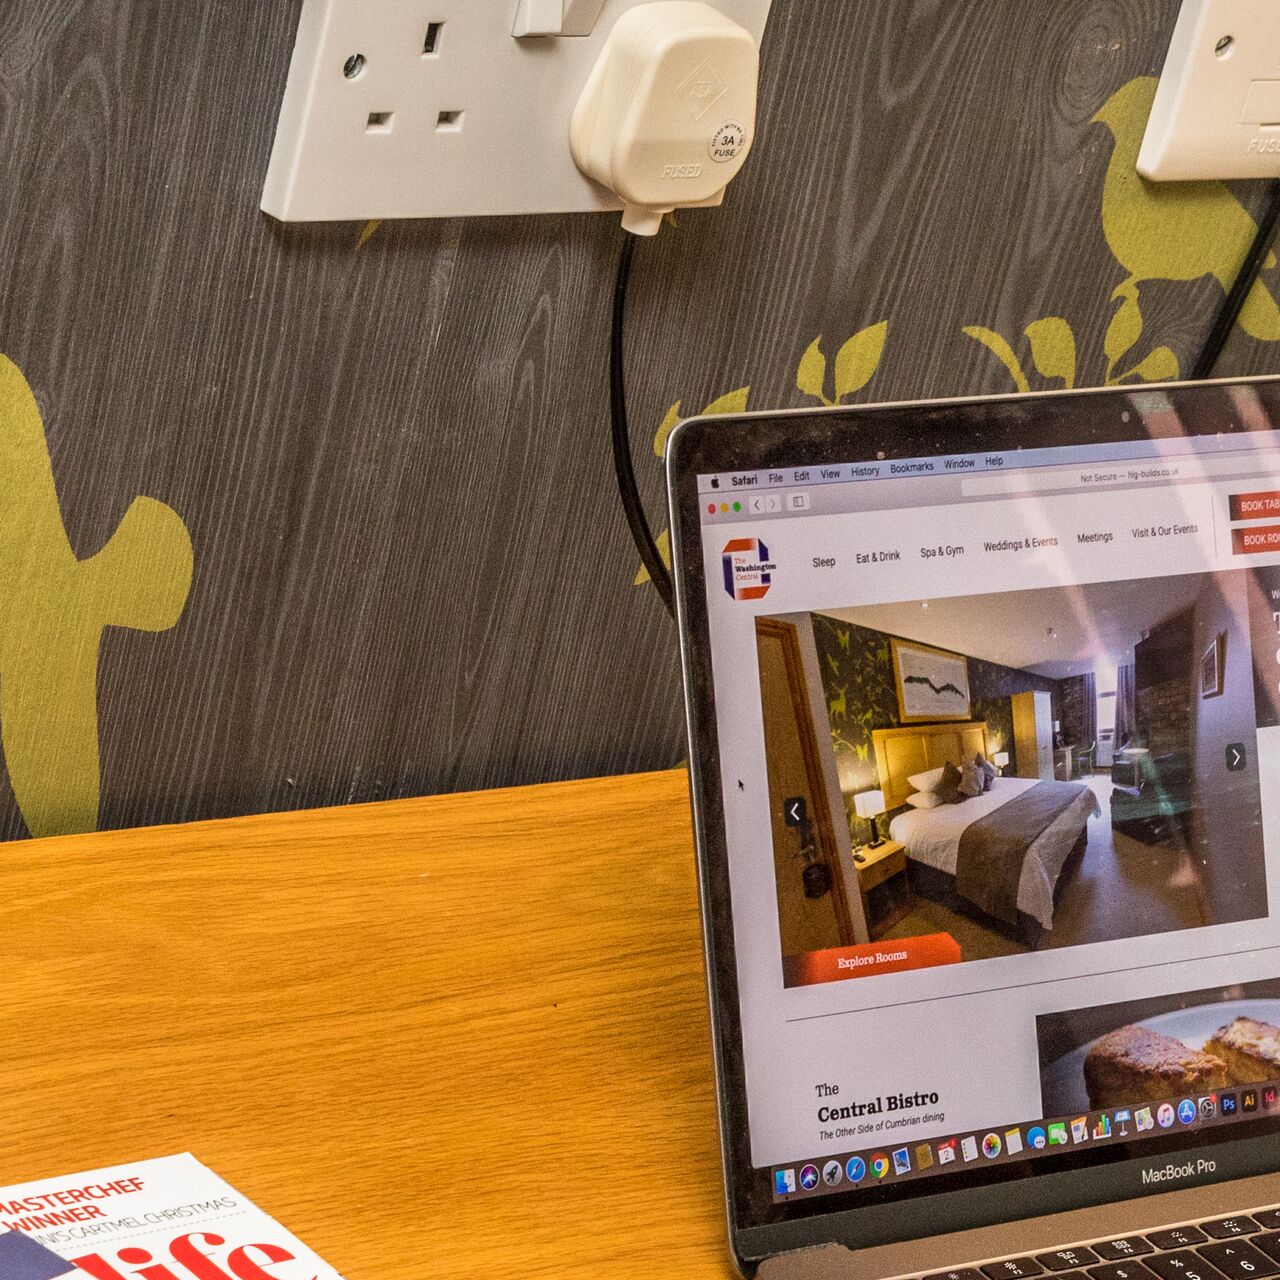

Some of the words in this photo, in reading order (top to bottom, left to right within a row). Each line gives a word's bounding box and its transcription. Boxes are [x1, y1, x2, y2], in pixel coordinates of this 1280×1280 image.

[721, 135, 735, 146] 3A
[714, 149, 736, 157] FUSE
[661, 165, 701, 179] FUSED
[732, 475, 758, 486] Safari
[769, 473, 783, 483] File
[794, 471, 810, 481] Edit
[821, 469, 841, 479] View
[851, 465, 879, 477] History
[890, 460, 934, 474] Bookmarks
[944, 456, 975, 470] Window
[985, 455, 1004, 468] Help
[1094, 473, 1117, 482] Secure
[1241, 499, 1264, 512] BOOK
[1077, 531, 1113, 544] Meetings
[1132, 528, 1150, 538] Visit
[1151, 527, 1157, 537] &
[1158, 526, 1172, 536] Our
[1173, 524, 1199, 535] Events
[984, 538, 1023, 553] Weddings
[1024, 538, 1031, 548] &
[1032, 535, 1058, 549] Events
[1244, 533, 1267, 545] BOOK
[856, 554, 869, 563] Eat
[870, 553, 878, 562] &
[879, 549, 901, 562] Drink
[920, 546, 938, 559] Spa
[939, 546, 946, 556] &
[947, 543, 965, 558] Gym
[735, 562, 776, 573] Washington
[813, 557, 836, 569] Sleep
[838, 953, 874, 970] Explore
[876, 948, 907, 964] Rooms
[815, 1083, 839, 1098] The
[818, 1098, 883, 1122] Central
[887, 1091, 939, 1112] Bistro
[1223, 1099, 1235, 1110] Ps
[1244, 1094, 1255, 1106] Ai
[820, 1130, 834, 1140] The
[836, 1126, 856, 1138] Other
[857, 1123, 874, 1134] Side
[875, 1121, 884, 1131] of
[885, 1116, 921, 1130] Cumbrian
[922, 1111, 945, 1123] dining
[1142, 1160, 1193, 1185] MacBook
[1196, 1158, 1217, 1176] Pro
[1, 1205, 108, 1232] WINNER
[68, 1217, 148, 1242] CARTMEL
[143, 1197, 237, 1223] CHRISTMAS
